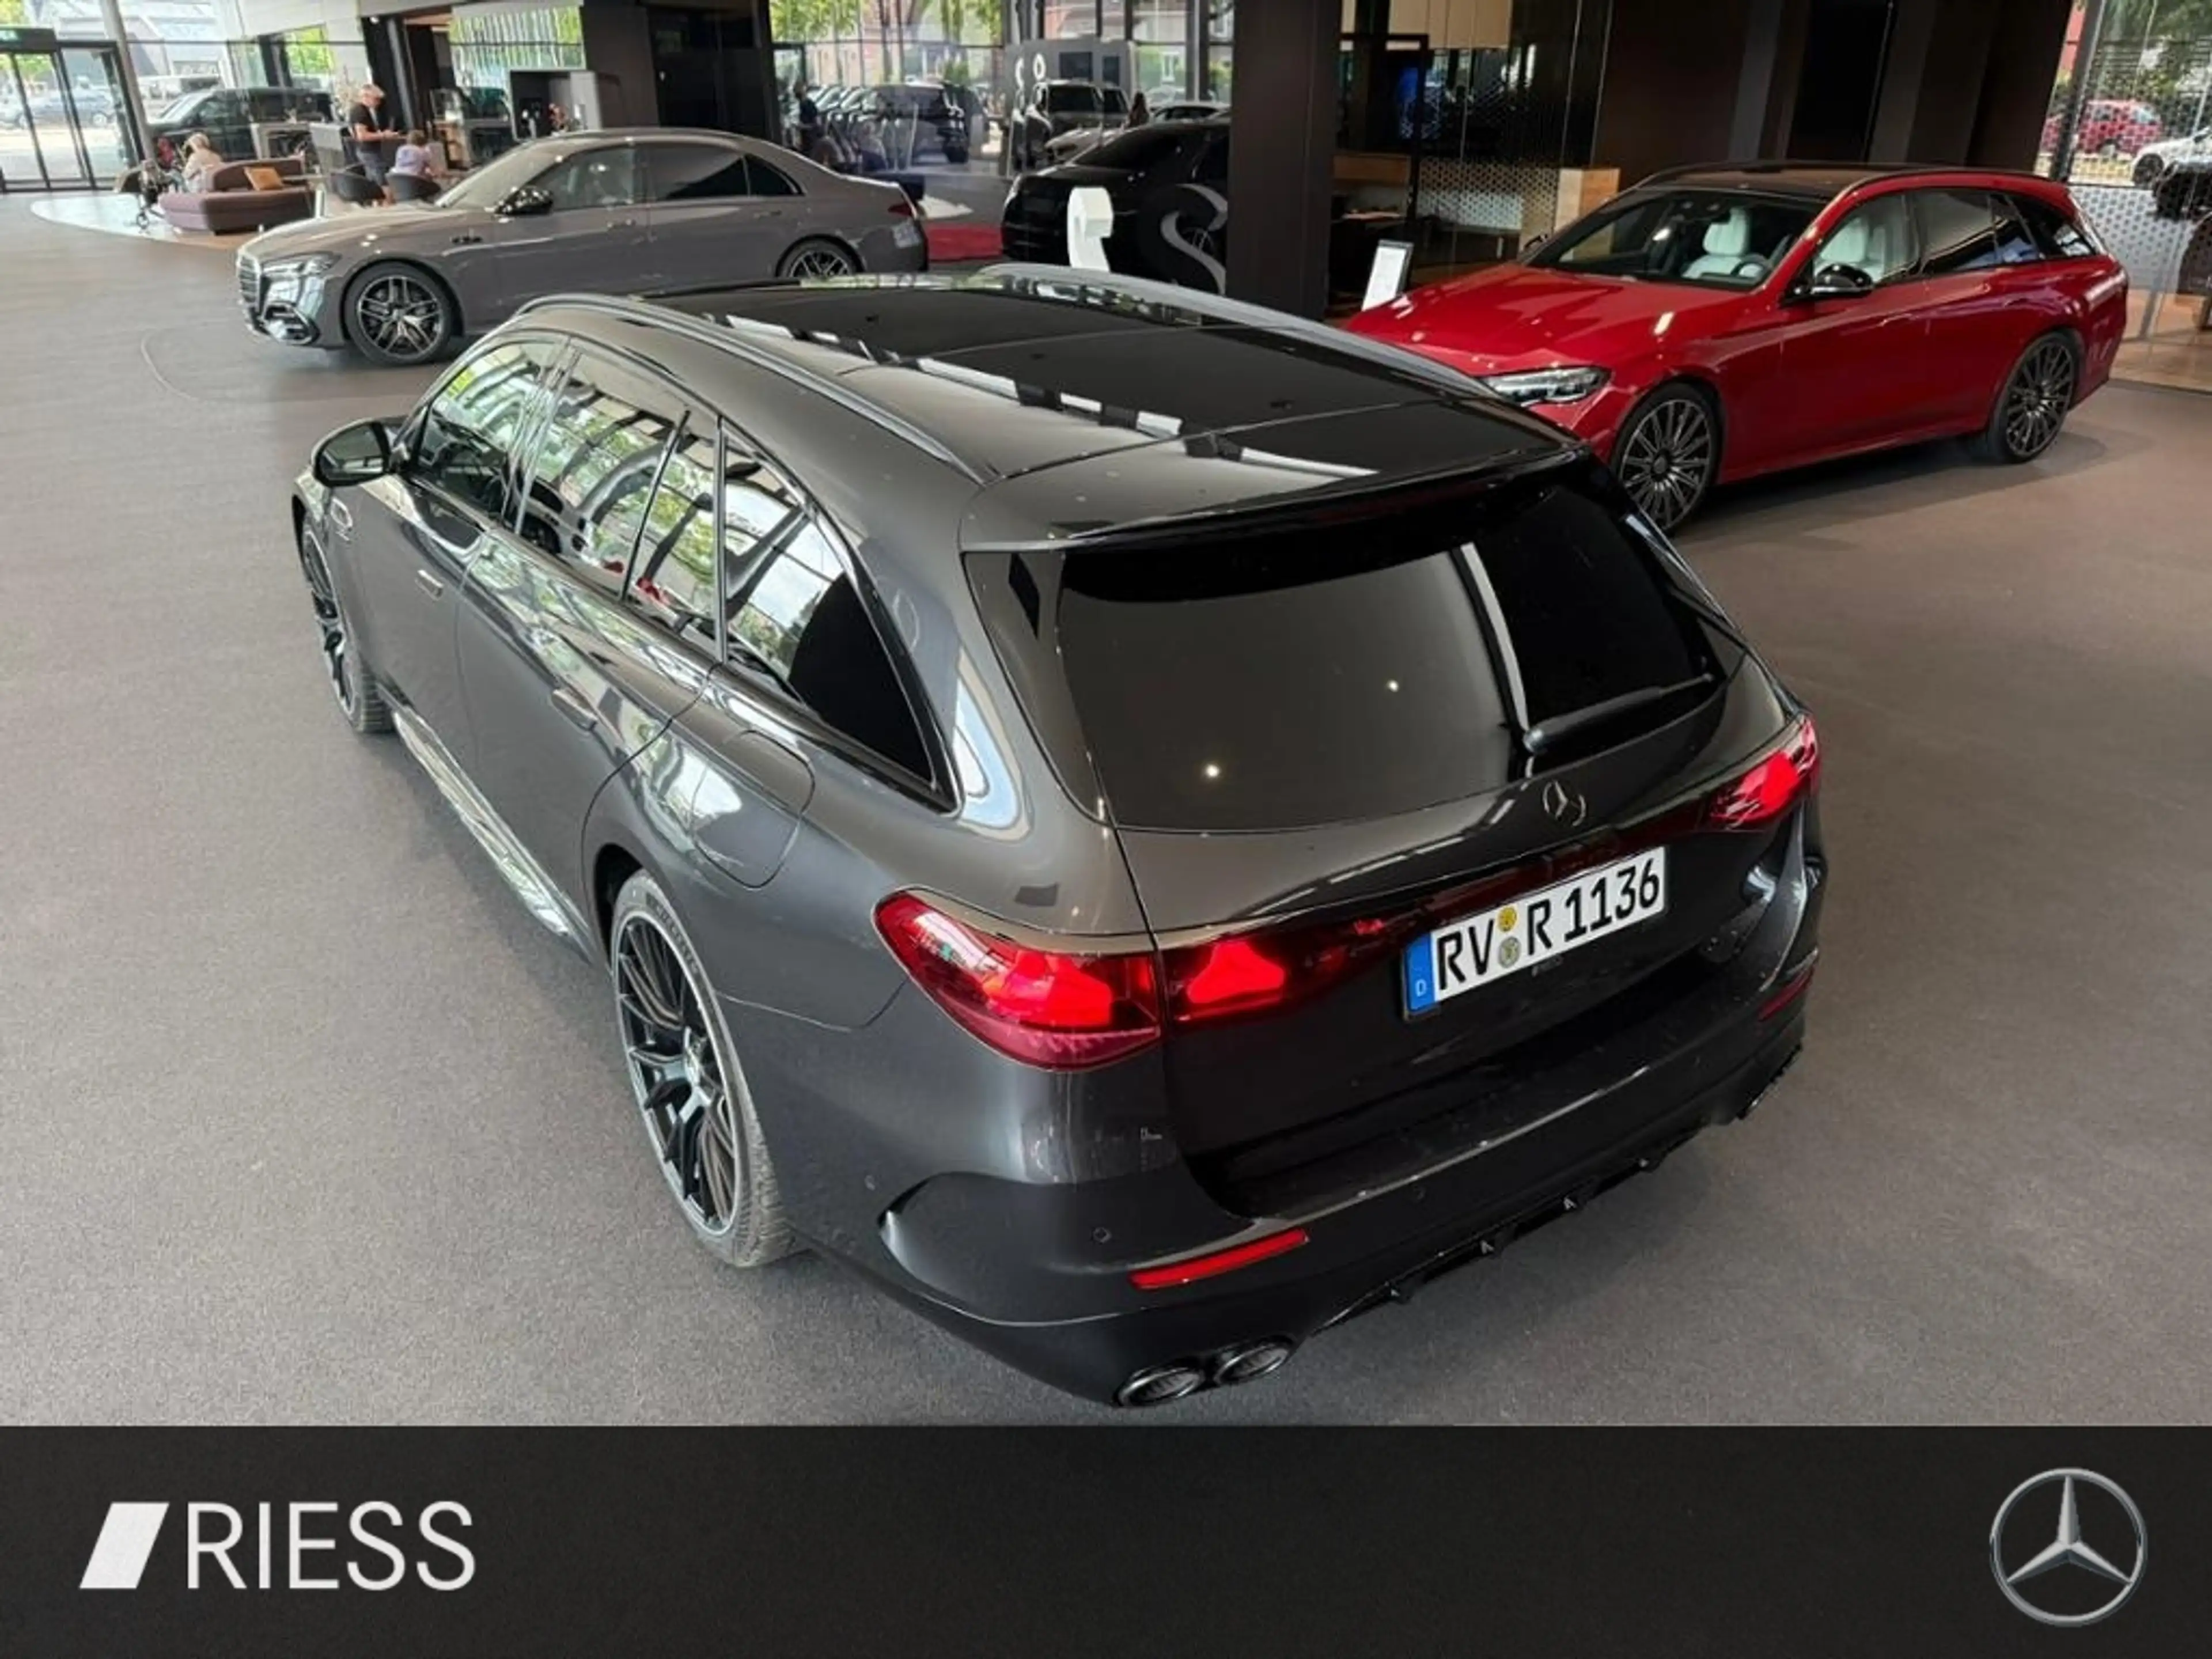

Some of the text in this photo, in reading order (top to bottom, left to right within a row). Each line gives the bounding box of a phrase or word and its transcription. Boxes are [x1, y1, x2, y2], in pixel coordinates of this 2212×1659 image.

[1437, 858, 1660, 990] RV R 1136
[1415, 979, 1425, 997] D
